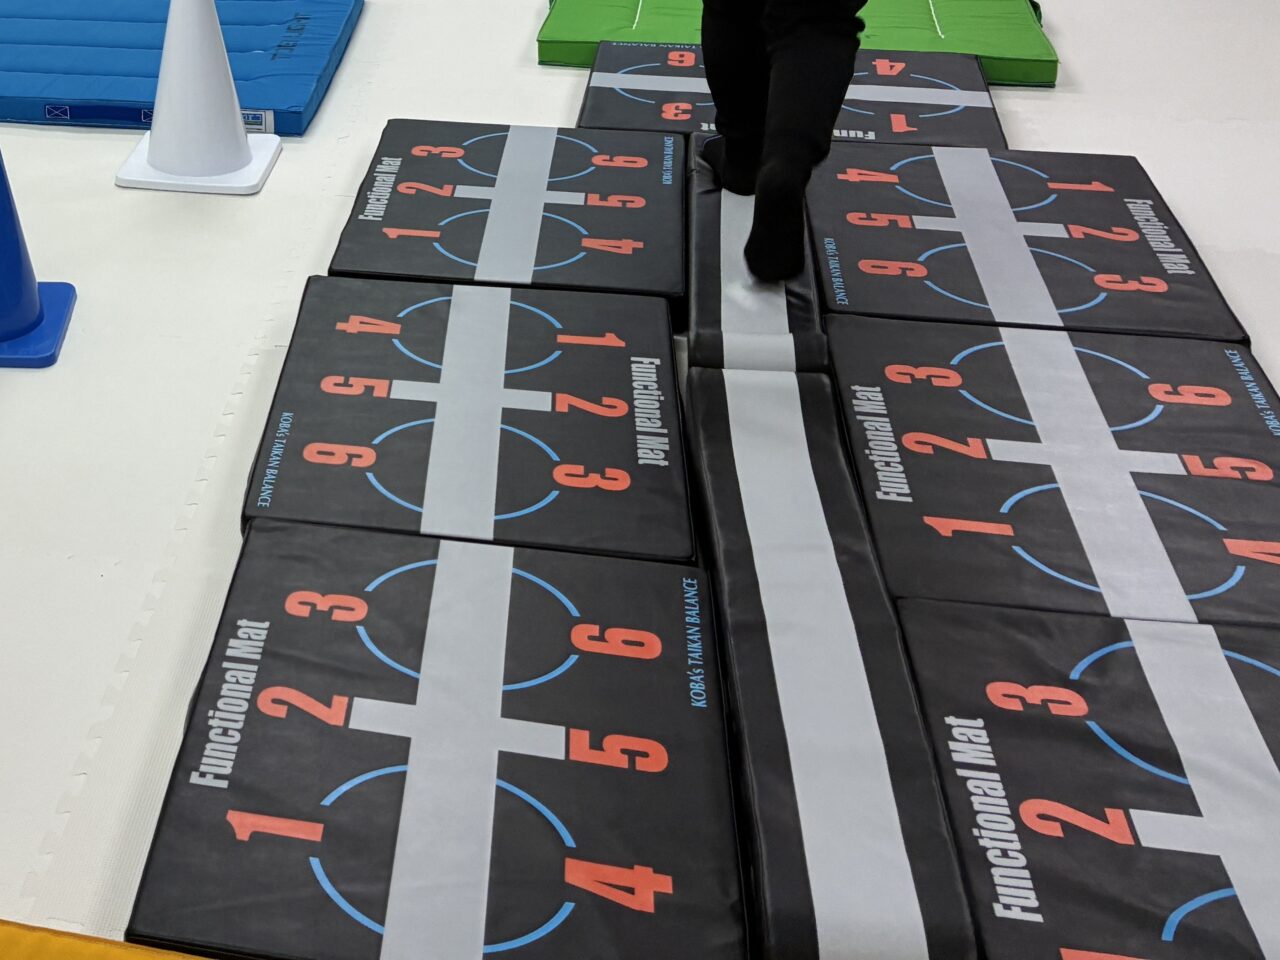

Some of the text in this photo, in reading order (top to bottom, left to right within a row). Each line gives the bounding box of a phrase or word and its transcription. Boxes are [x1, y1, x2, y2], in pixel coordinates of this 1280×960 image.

[872, 59, 906, 76] 4
[660, 102, 693, 121] 3
[889, 113, 918, 133] 1
[411, 145, 465, 159] 3
[591, 154, 649, 169] 6
[358, 157, 402, 220] Functional Mat
[837, 167, 900, 184] 4
[1047, 181, 1116, 192] 1
[396, 181, 454, 197] 2
[586, 193, 646, 209] 5
[382, 227, 441, 239] 1
[846, 211, 913, 229] 5
[1066, 223, 1140, 242] 2
[581, 237, 645, 255] 4
[1123, 199, 1196, 275] Functional Mat
[857, 259, 929, 278] 6
[1093, 273, 1169, 293] 3
[335, 315, 402, 335] 4
[556, 332, 626, 348] 1
[320, 375, 390, 398] 5
[884, 364, 963, 388] 3
[555, 392, 630, 418] 2
[1148, 383, 1233, 407] 6
[630, 356, 669, 466] Functional Mat
[302, 442, 377, 468] 6
[850, 385, 913, 502] Functional Mat
[901, 431, 988, 460] 2
[257, 412, 294, 508] KOBA's TAIKAN BALANCE
[1182, 454, 1275, 482] 5
[552, 463, 632, 491] 3
[923, 515, 1015, 537] 1
[1223, 538, 1280, 566] 4
[284, 591, 369, 623] 3
[570, 623, 663, 660] 6
[682, 577, 708, 708] KOBA's TAIKAN BALANCE
[189, 618, 270, 789] Functional Mat
[256, 686, 349, 728] 2
[985, 681, 1090, 717] 3
[568, 727, 669, 773] 5
[226, 809, 325, 842] 1
[945, 715, 1044, 923] Functional Mat
[1019, 798, 1136, 846] 2
[564, 857, 674, 914] 4
